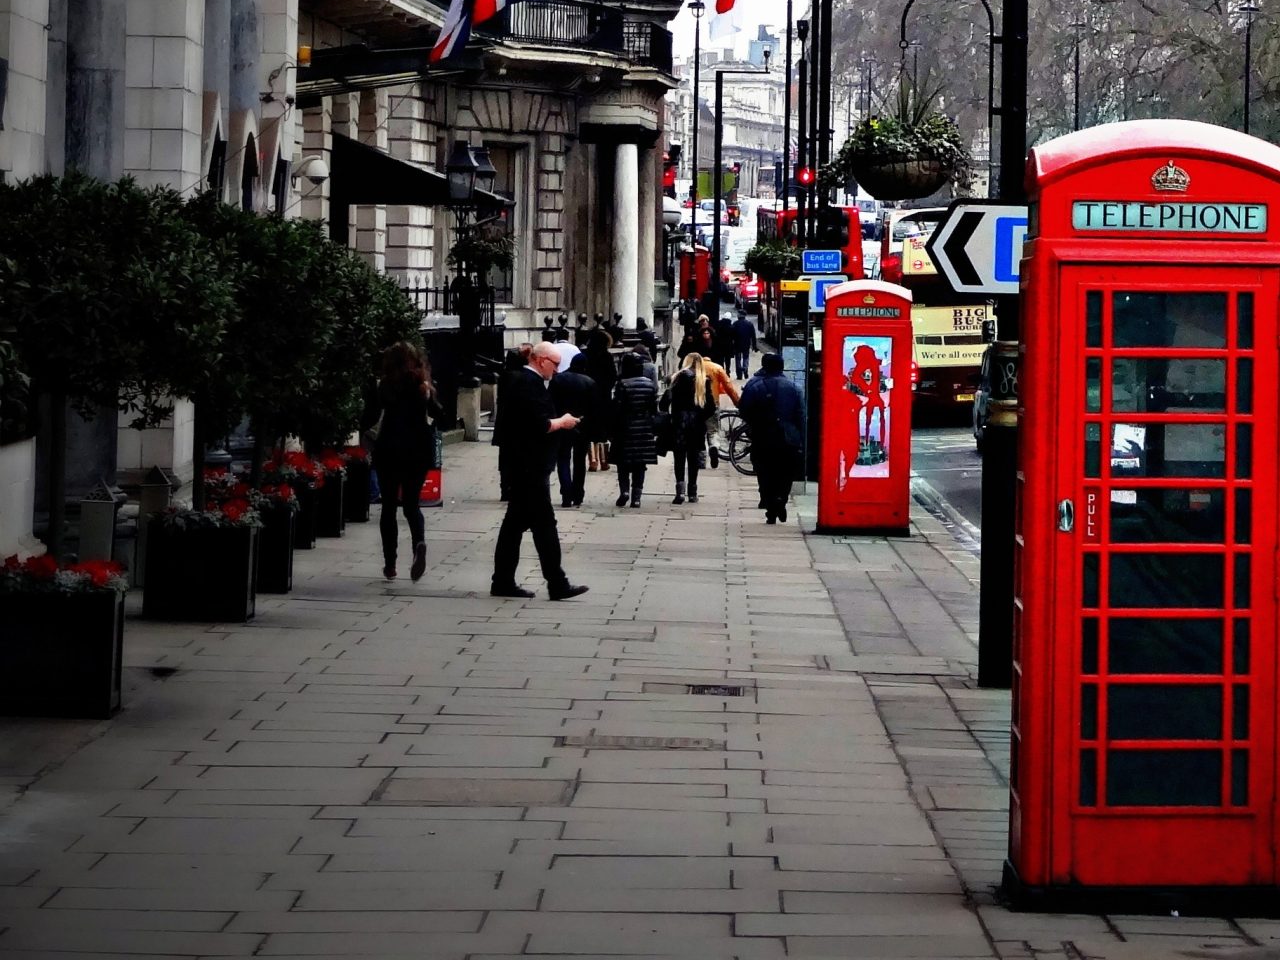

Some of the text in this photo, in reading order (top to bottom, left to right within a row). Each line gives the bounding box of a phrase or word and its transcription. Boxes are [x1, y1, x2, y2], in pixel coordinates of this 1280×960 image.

[1079, 202, 1260, 230] TELEPHONE
[837, 307, 901, 318] TELEPHONE
[953, 308, 985, 317] BIG
[953, 317, 985, 326] BUS
[921, 351, 947, 359] We're
[949, 351, 960, 359] all
[1087, 493, 1096, 536] PULL
